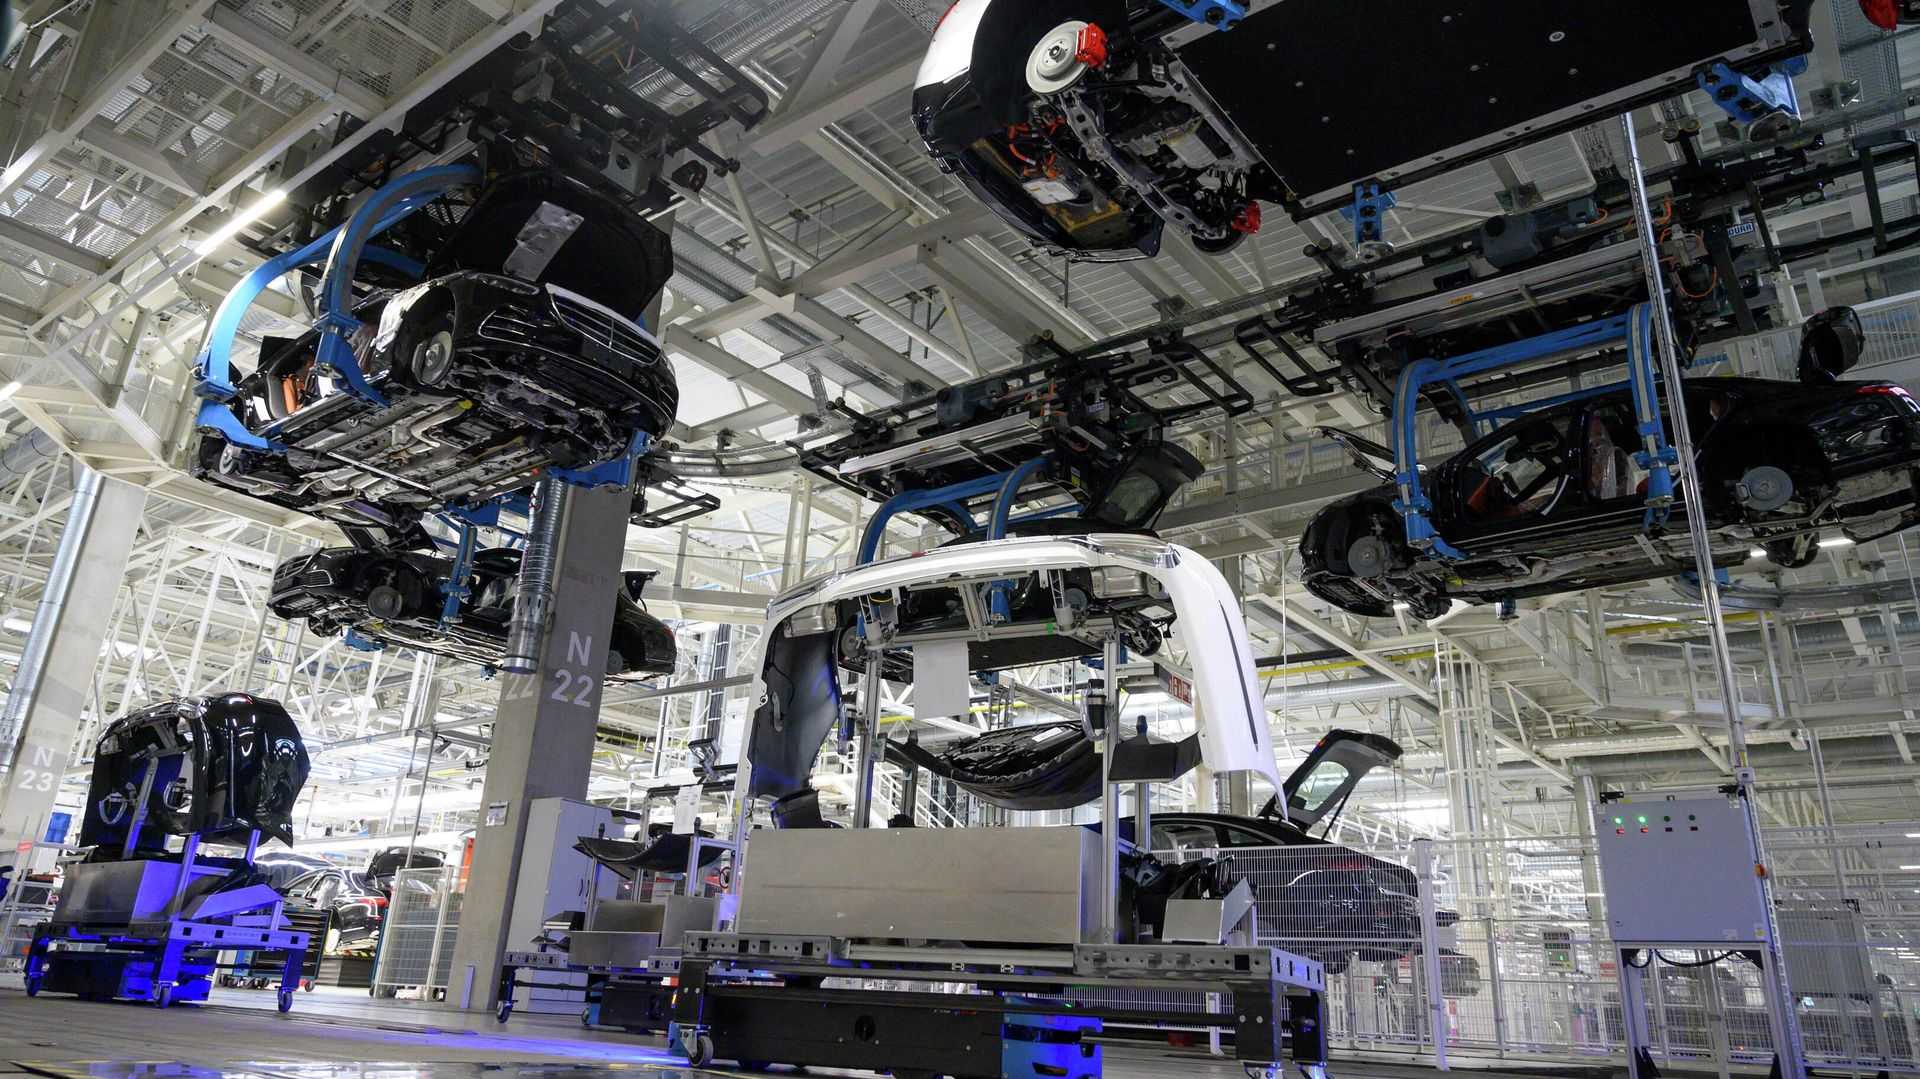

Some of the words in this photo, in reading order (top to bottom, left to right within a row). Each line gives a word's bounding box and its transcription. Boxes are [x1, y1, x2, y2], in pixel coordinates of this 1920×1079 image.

[566, 631, 592, 667] N
[551, 669, 594, 708] 22
[33, 745, 55, 768] N
[18, 769, 54, 792] 23
